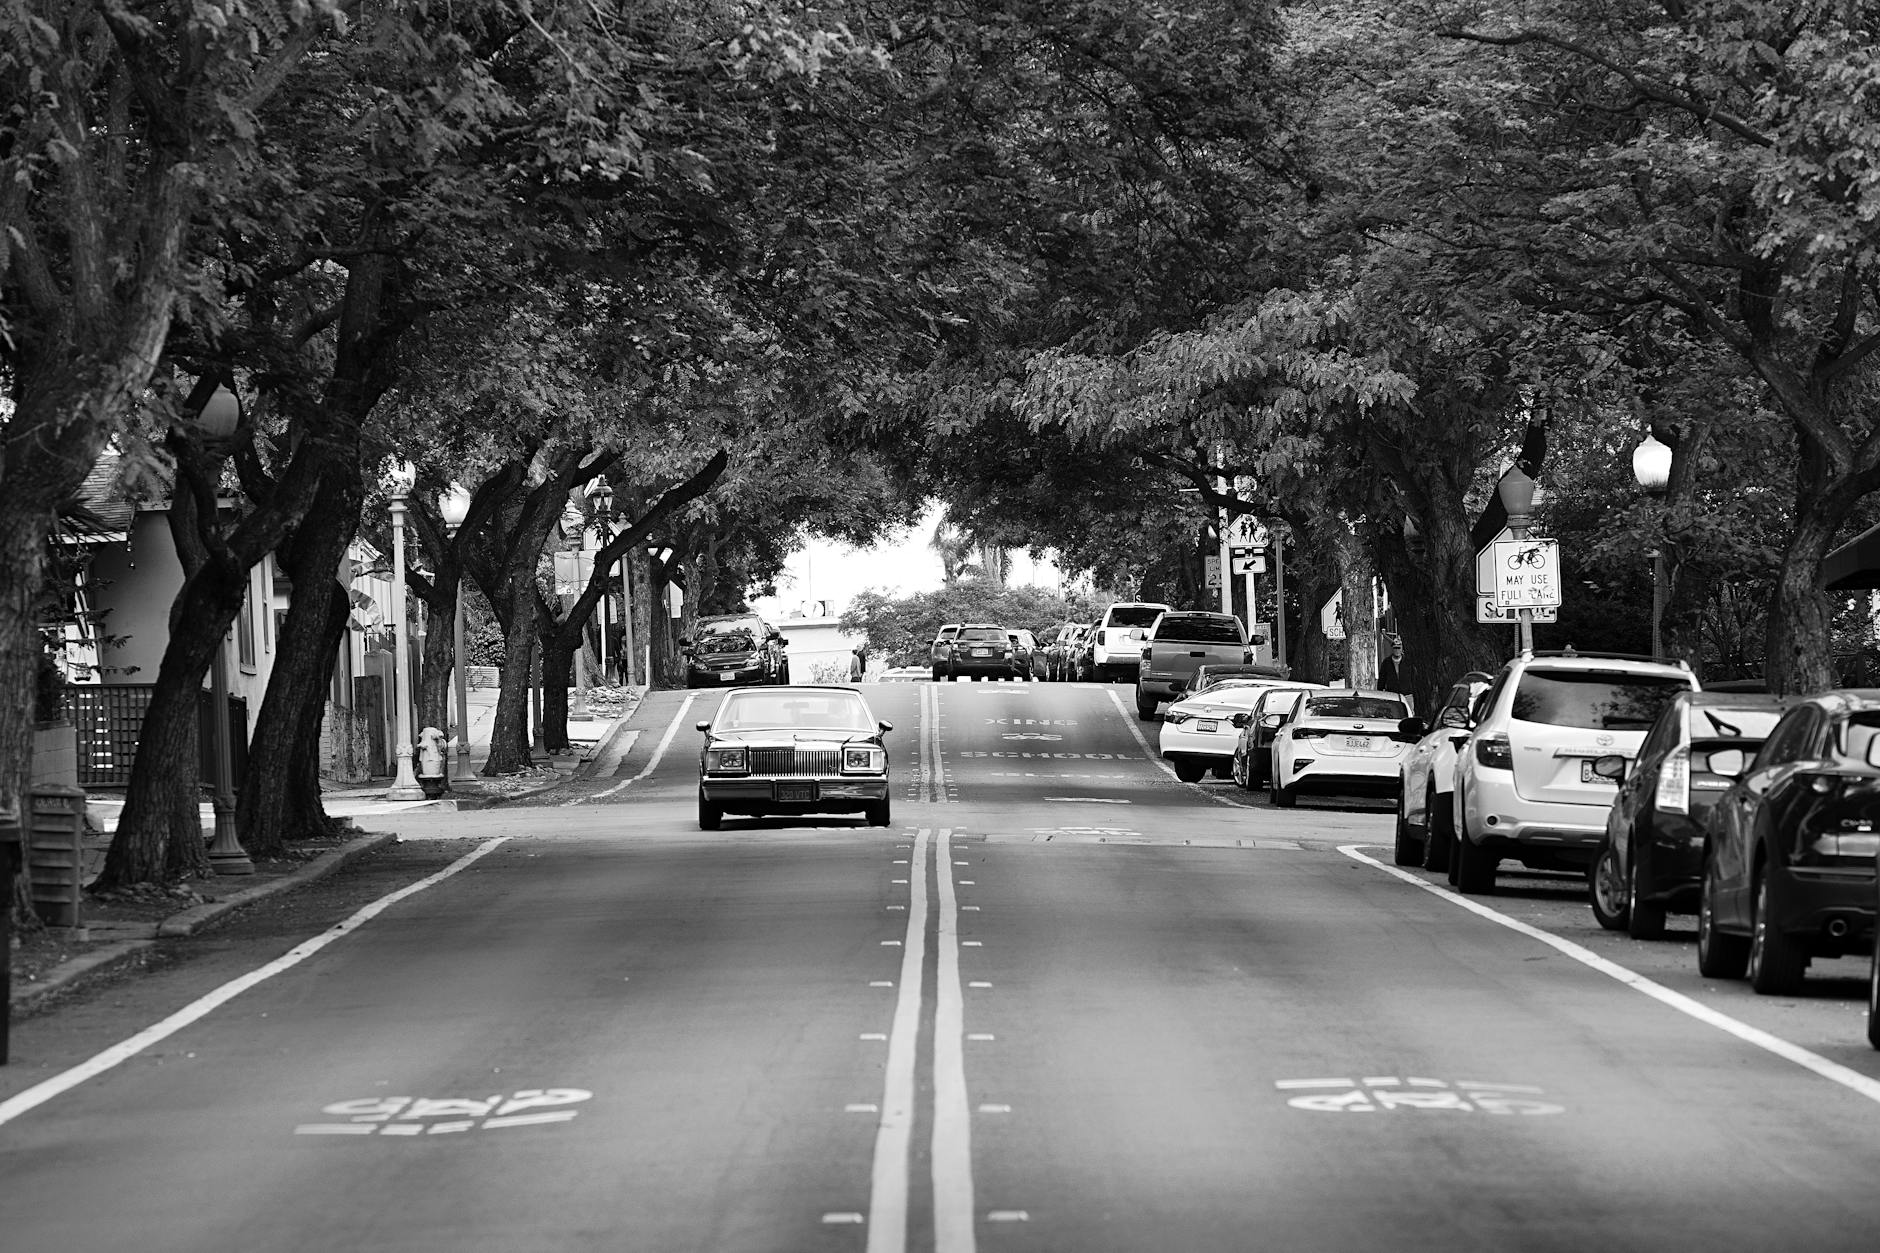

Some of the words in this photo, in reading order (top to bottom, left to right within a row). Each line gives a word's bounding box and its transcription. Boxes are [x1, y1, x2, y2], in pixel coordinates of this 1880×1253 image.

[1506, 575, 1524, 585] MAY
[1530, 574, 1549, 584] USE
[984, 718, 1079, 726] XING
[960, 751, 1147, 760] SCHOOL
